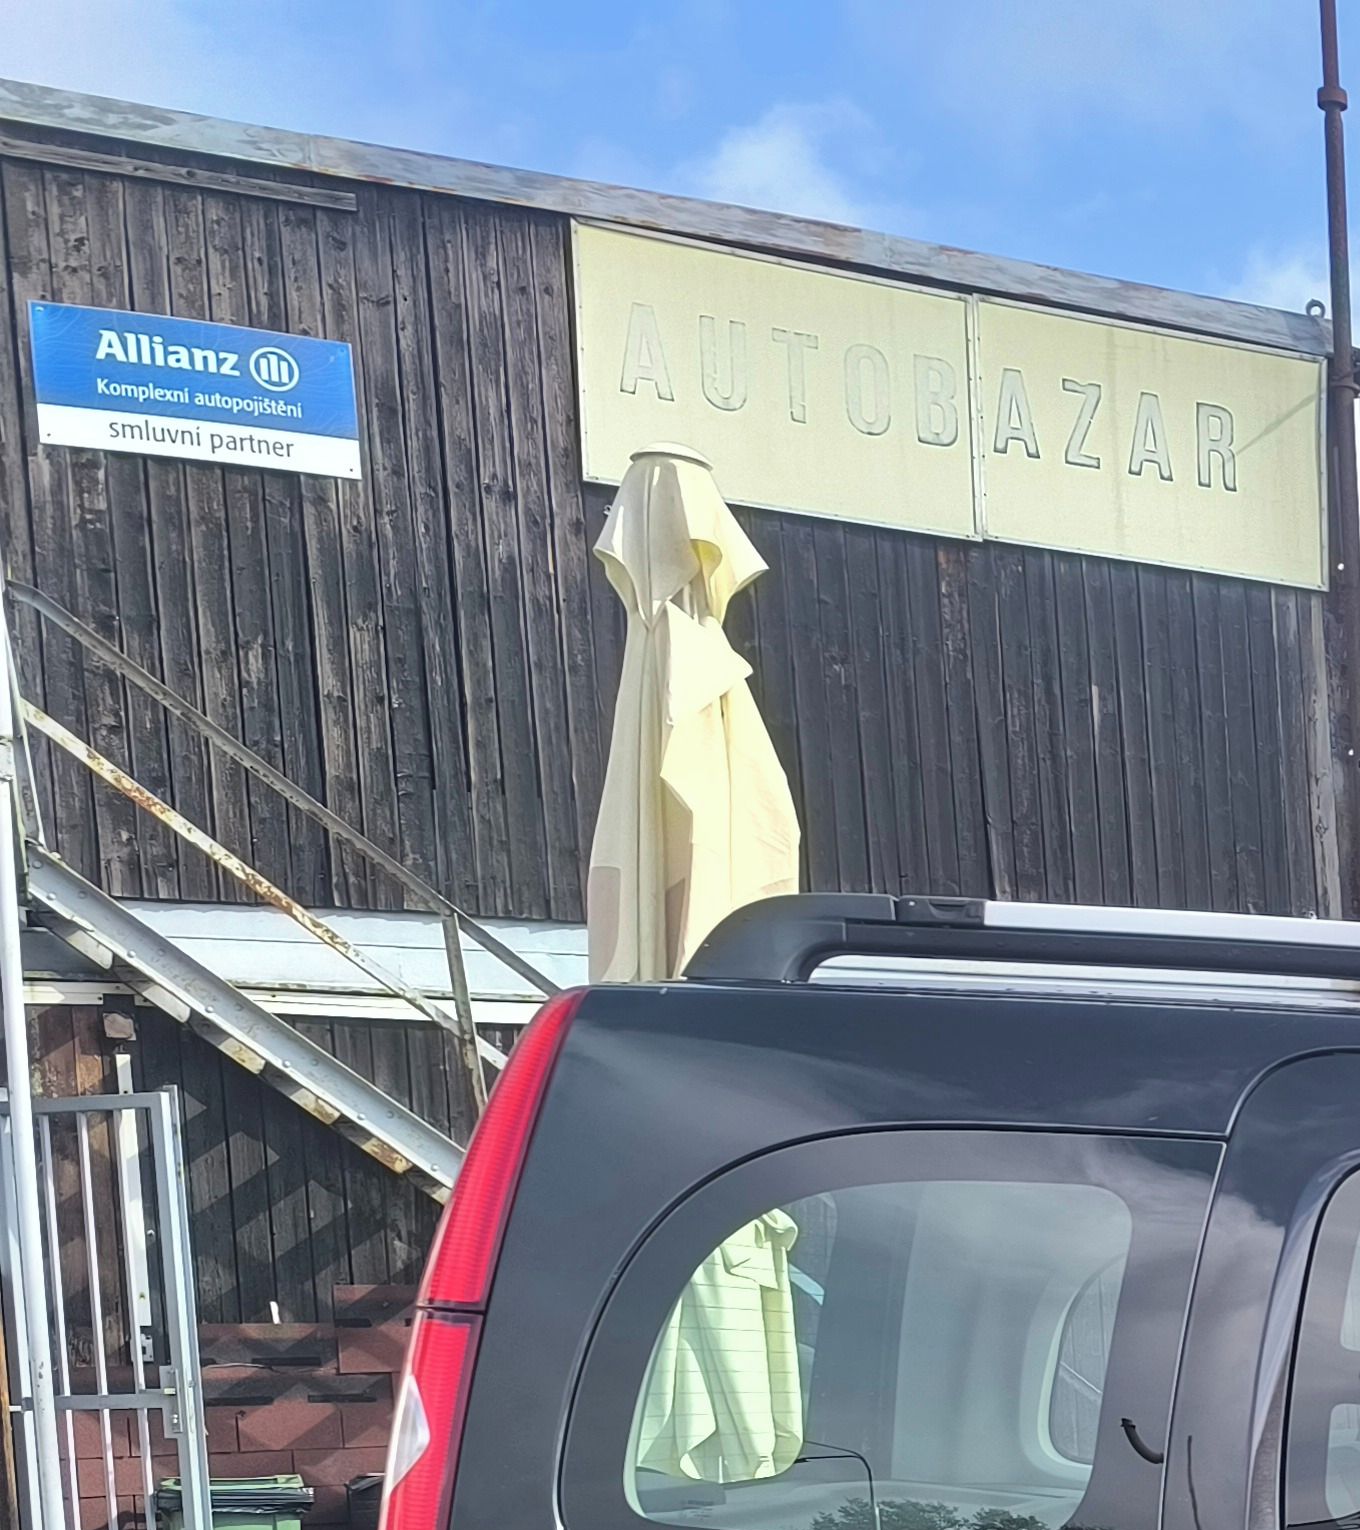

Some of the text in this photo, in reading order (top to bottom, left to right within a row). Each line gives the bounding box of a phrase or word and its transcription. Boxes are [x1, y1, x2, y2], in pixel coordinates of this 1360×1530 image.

[96, 330, 241, 377] Allianz
[96, 378, 302, 419] Komplexní autopojištění
[619, 302, 1238, 492] AUTOBAZAR
[109, 419, 294, 458] smluvní partner
